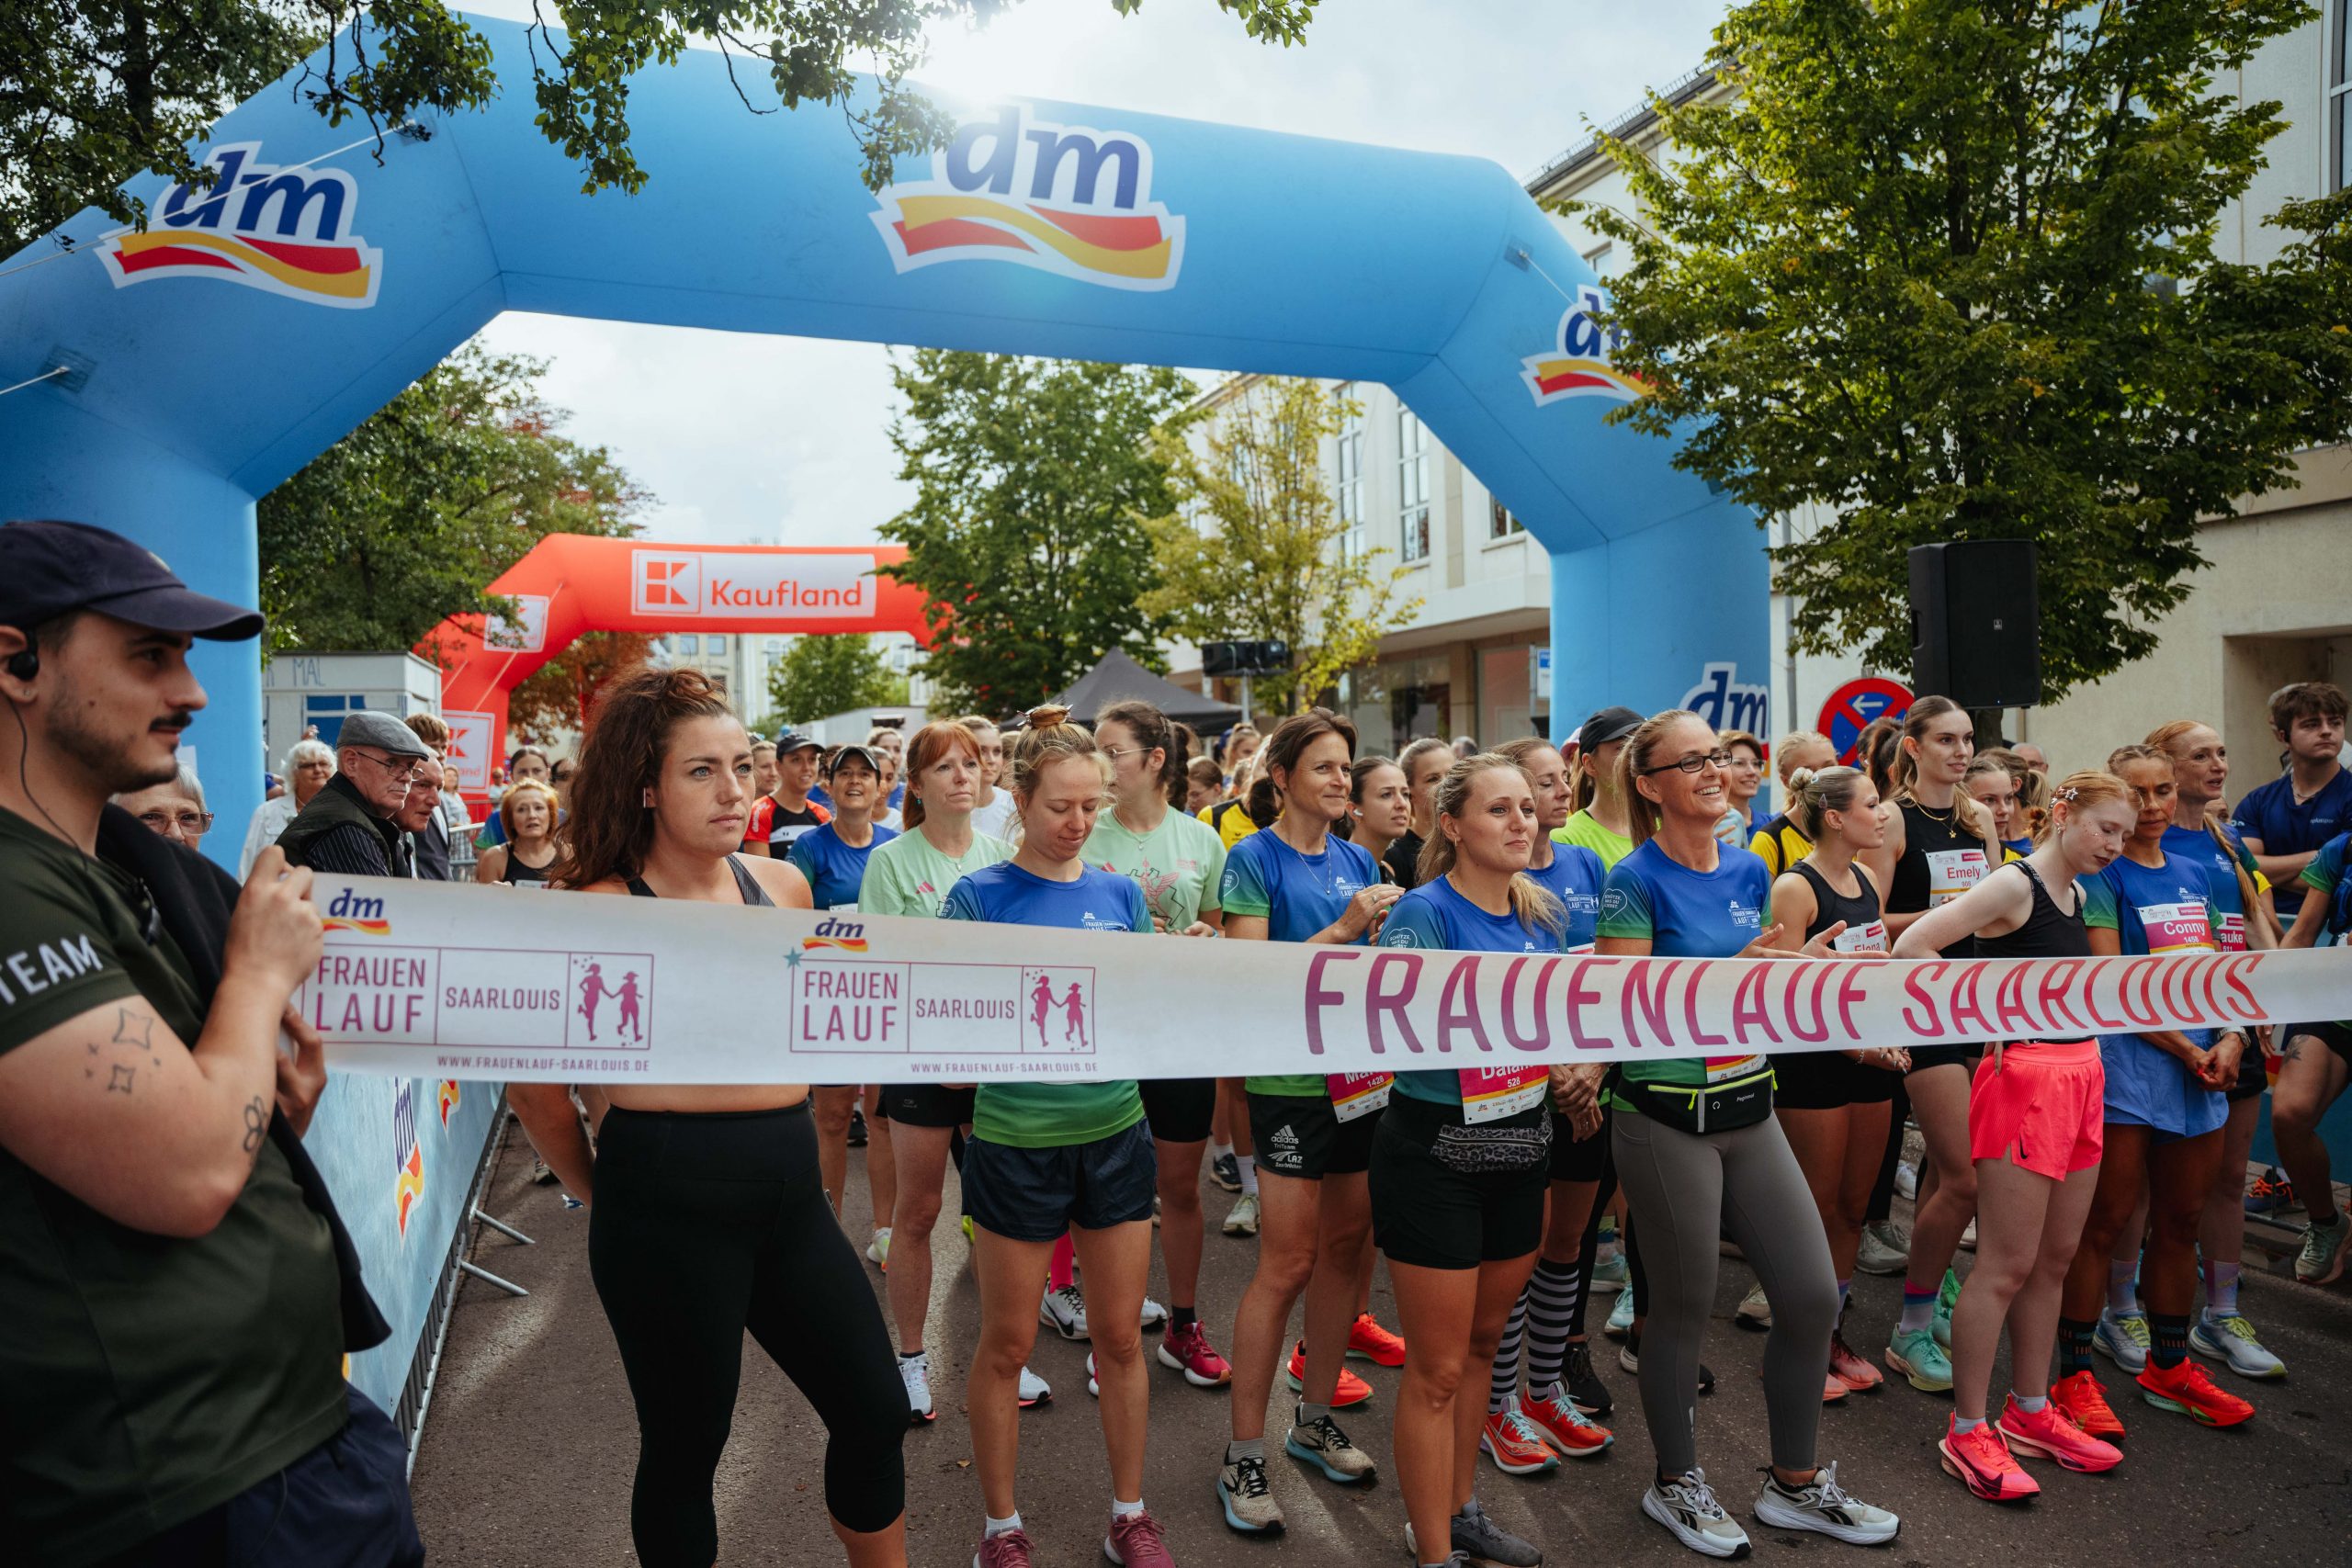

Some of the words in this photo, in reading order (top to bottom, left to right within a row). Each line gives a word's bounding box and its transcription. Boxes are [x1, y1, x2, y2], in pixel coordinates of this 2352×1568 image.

[946, 105, 1138, 209] dm
[164, 150, 345, 242] dm
[711, 580, 862, 607] Kaufland
[1687, 671, 1767, 739] dm
[1947, 865, 1980, 880] Emely
[329, 887, 384, 919] dm
[815, 917, 865, 939] dm
[2164, 921, 2206, 936] Conny
[2220, 931, 2244, 944] auke
[0, 933, 104, 1005] TEAM
[317, 955, 426, 988] FRAUEN
[804, 970, 899, 999] FRAUEN
[446, 987, 560, 1010] SAARLOUIS
[916, 998, 1015, 1020] SAARLOUIS
[1304, 950, 1892, 1055] FRAUENLAUF
[1902, 953, 2268, 1037] SAARLOUIS
[315, 993, 424, 1032] LAUF
[803, 1004, 897, 1042] LAUF
[437, 1055, 650, 1072] WWW.FRAUENLAUF-SAARLOUIS.DE
[911, 1063, 1098, 1073] WWW.FRAUENLAUF-SAARLOUIS.DE
[1271, 1135, 1299, 1145] adidas
[1287, 1155, 1303, 1164] LAZ
